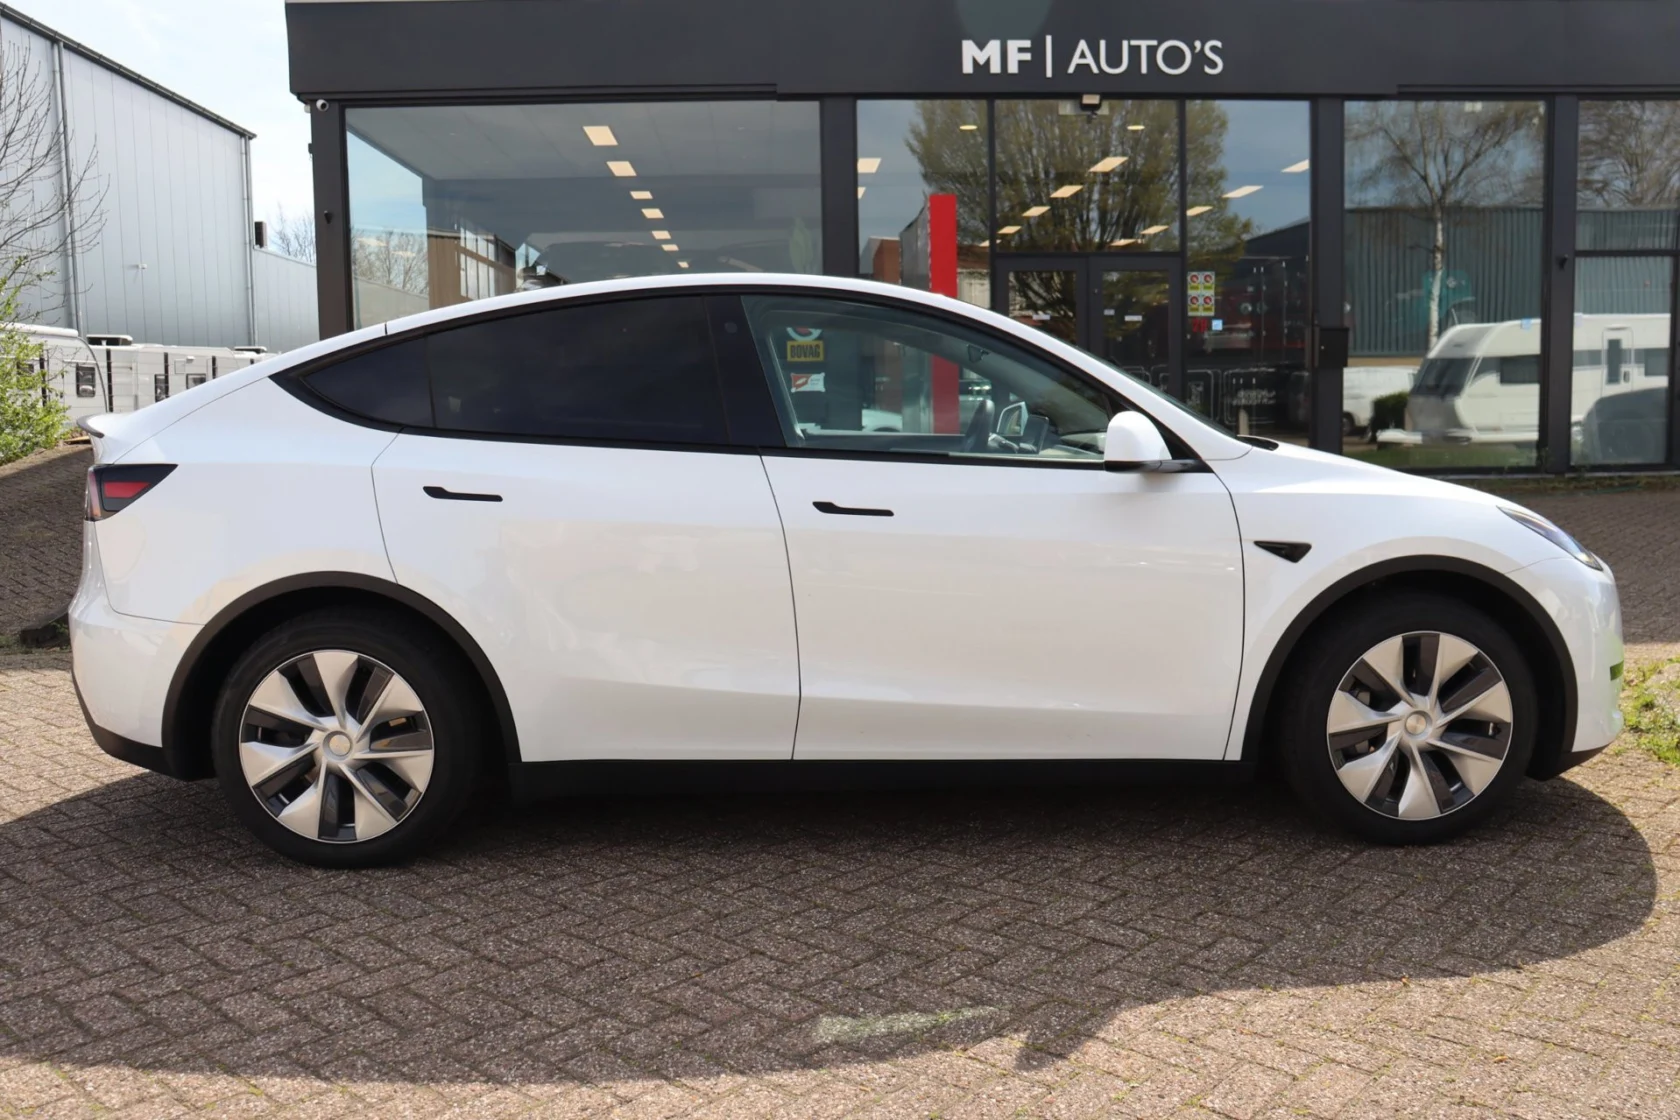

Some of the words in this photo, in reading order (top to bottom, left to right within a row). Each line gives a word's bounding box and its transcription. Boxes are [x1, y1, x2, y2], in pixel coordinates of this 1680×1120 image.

[961, 39, 1032, 74] MF
[1067, 39, 1224, 75] AUTO'S
[790, 344, 821, 359] BOVAG
